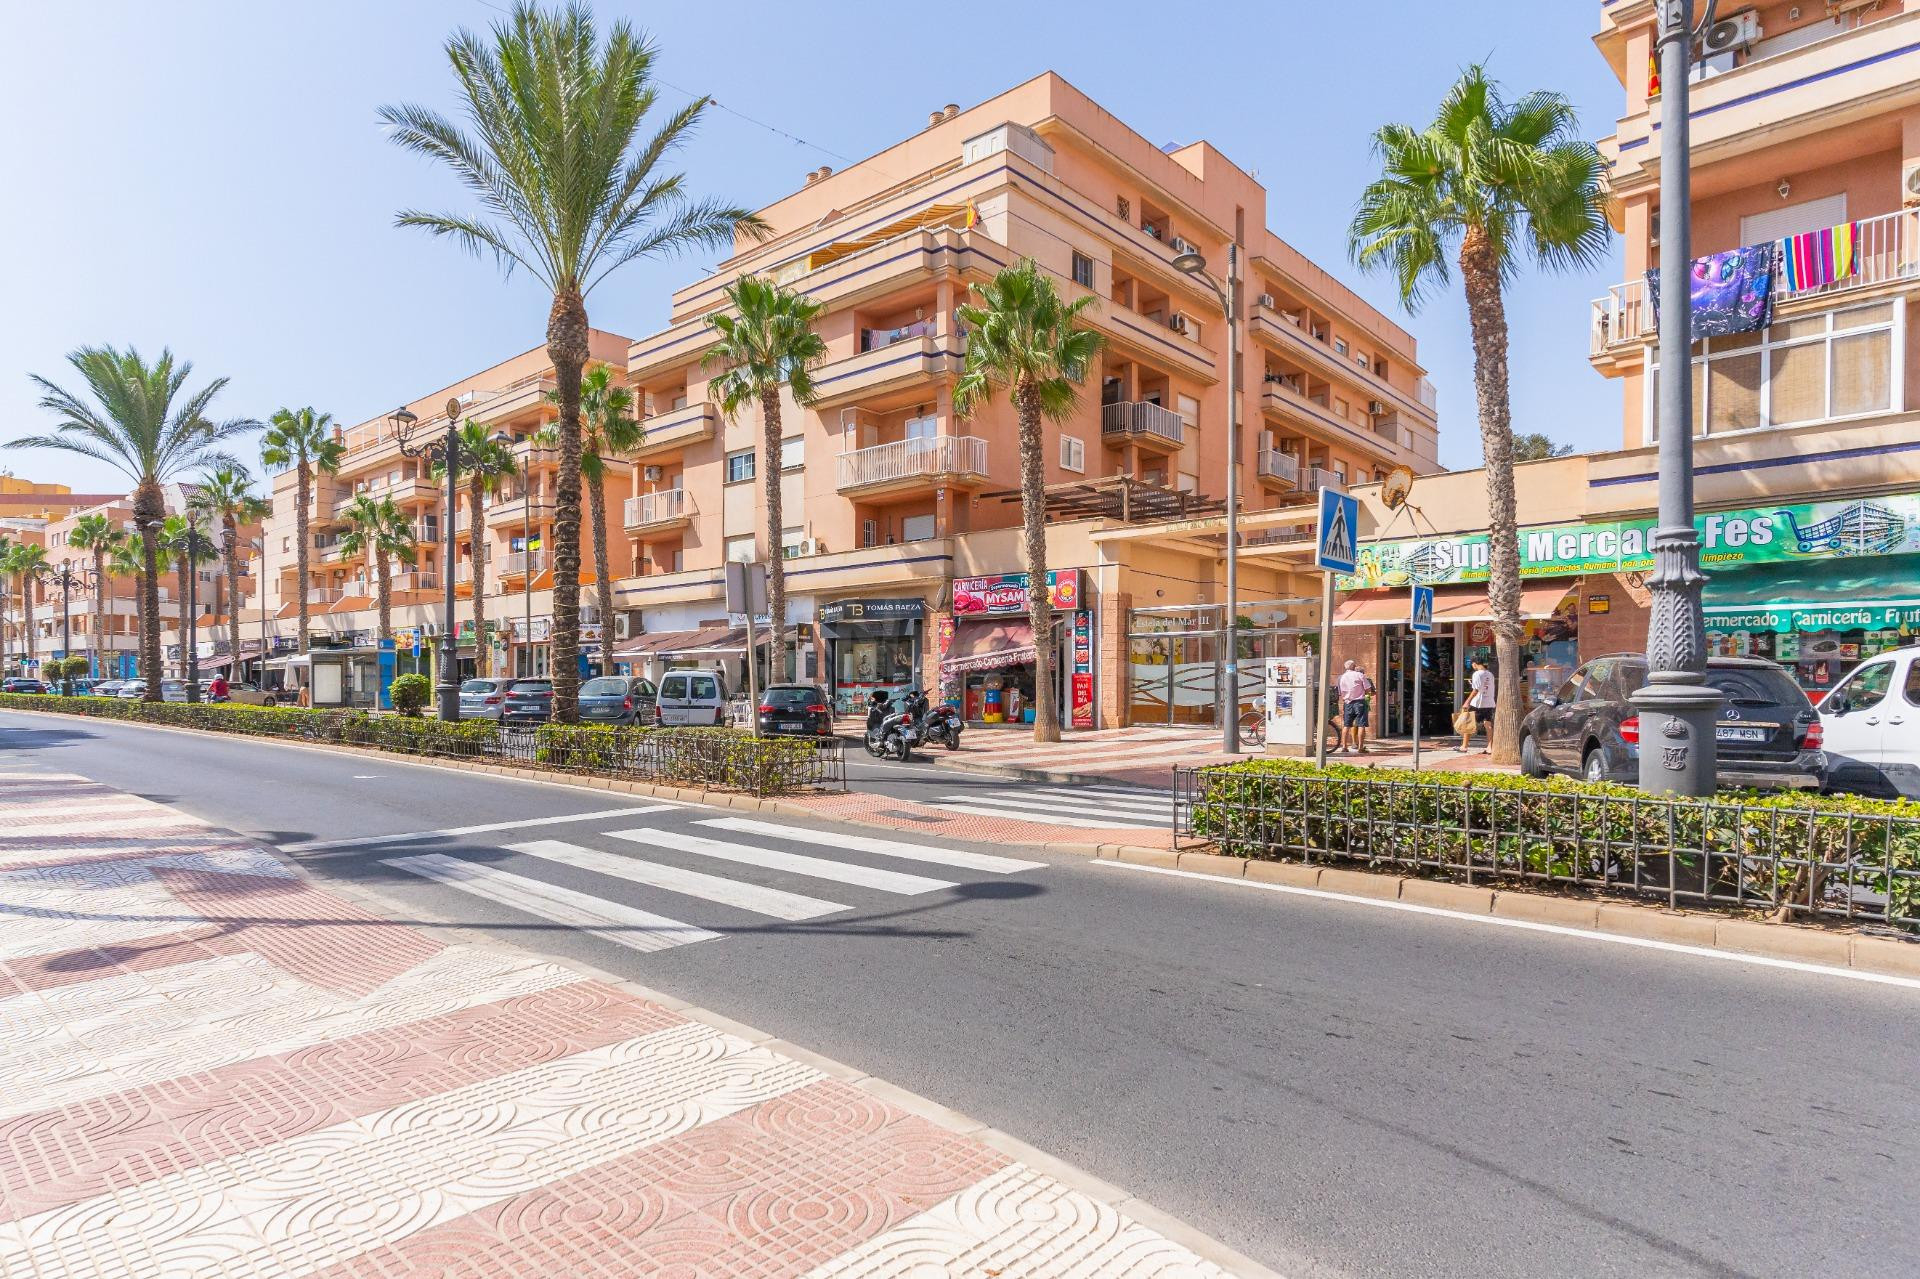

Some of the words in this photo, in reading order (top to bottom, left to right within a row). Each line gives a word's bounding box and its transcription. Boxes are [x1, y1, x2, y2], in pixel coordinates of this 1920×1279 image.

[1704, 514, 1774, 549] Fes
[1542, 564, 1581, 577] productos
[1583, 558, 1617, 572] Rumano
[1702, 552, 1744, 563] limpieza
[986, 590, 1024, 604] MYSAM
[1136, 617, 1161, 627] Estela
[1162, 617, 1176, 626] del
[1178, 616, 1196, 626] Mar
[1198, 615, 1210, 625] III
[1704, 611, 1779, 628] ermercado
[1792, 608, 1872, 626] Carnicería
[1716, 729, 1735, 738] 487
[1740, 730, 1759, 739] MSN
